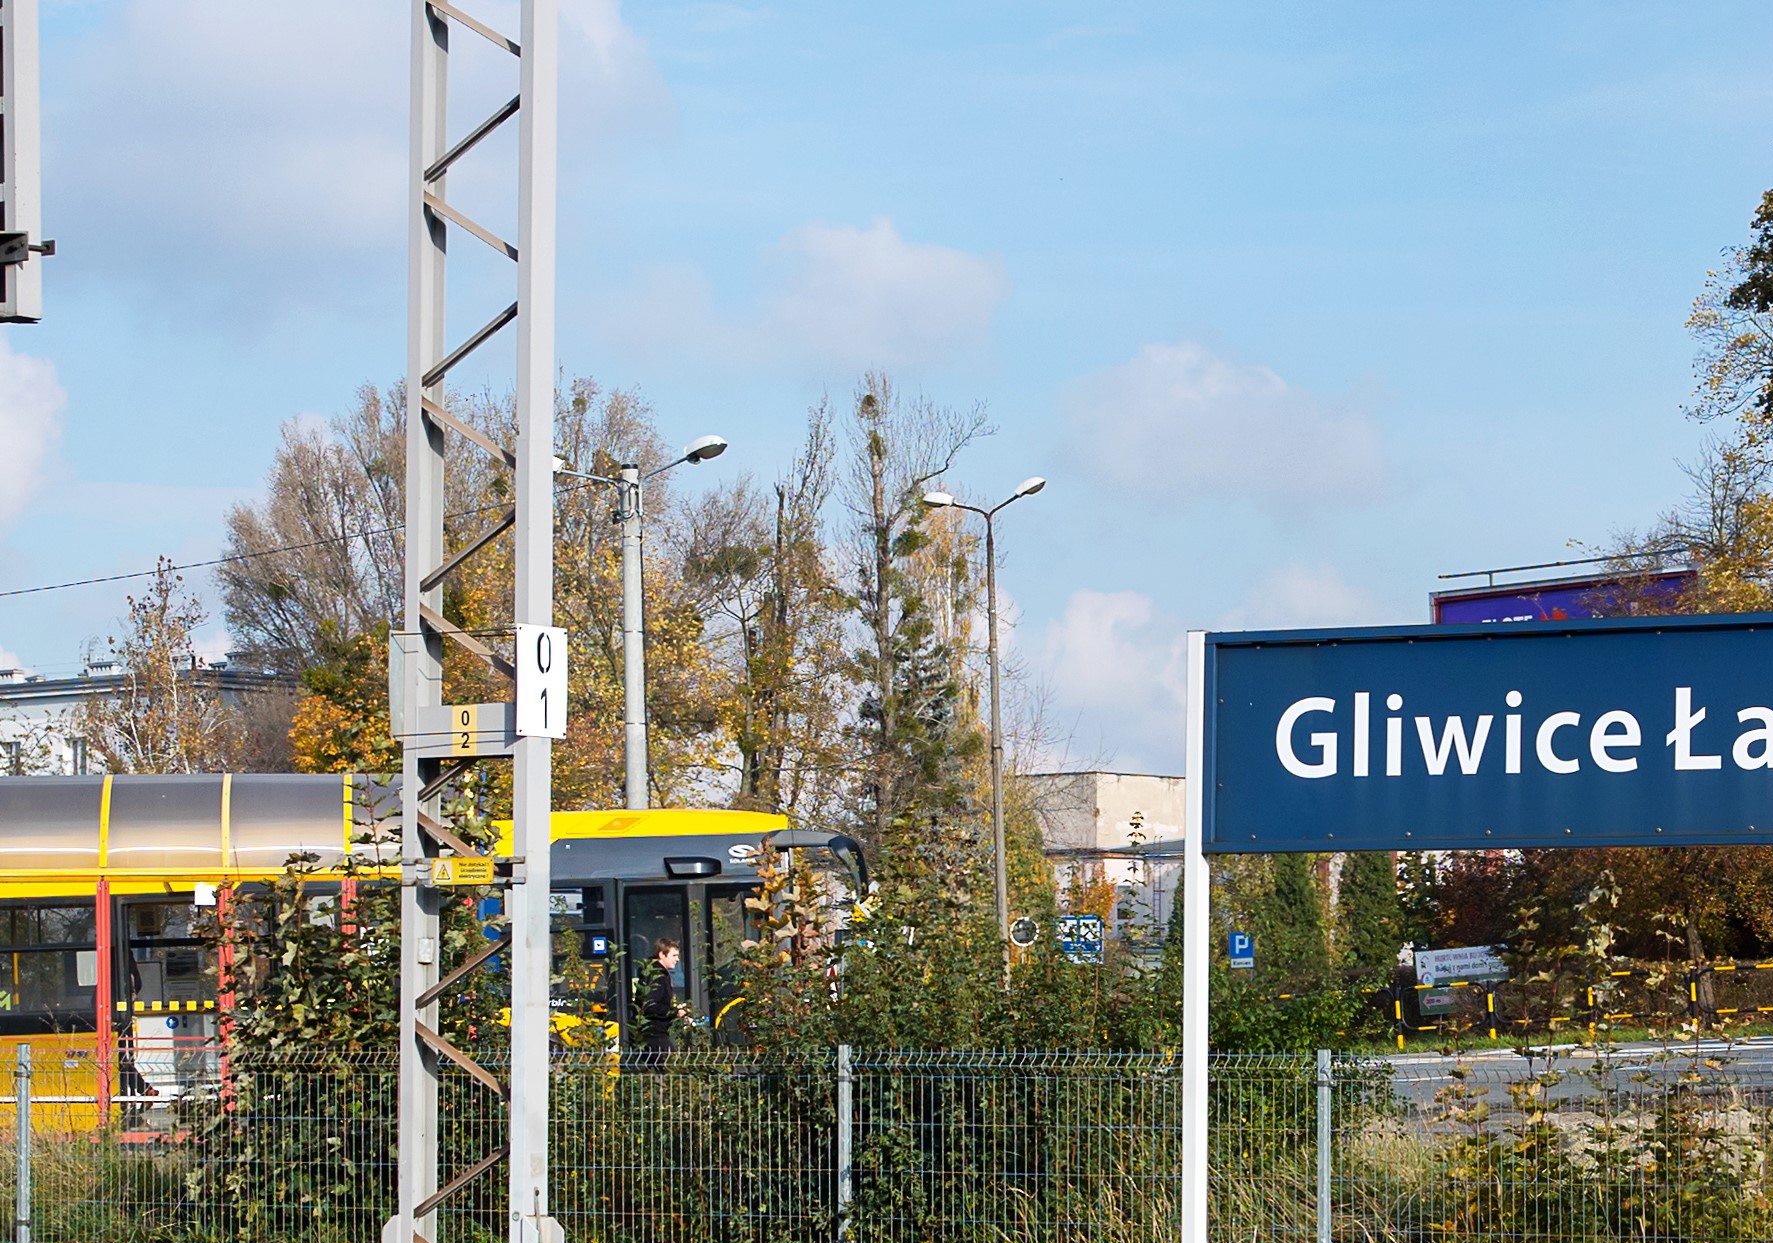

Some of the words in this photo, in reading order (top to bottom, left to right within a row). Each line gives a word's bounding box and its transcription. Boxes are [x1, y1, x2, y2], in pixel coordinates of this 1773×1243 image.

[537, 632, 551, 674] 0
[461, 710, 470, 726] 0
[540, 687, 547, 729] 1
[461, 732, 470, 748] 2
[1276, 691, 1641, 778] Gliwice
